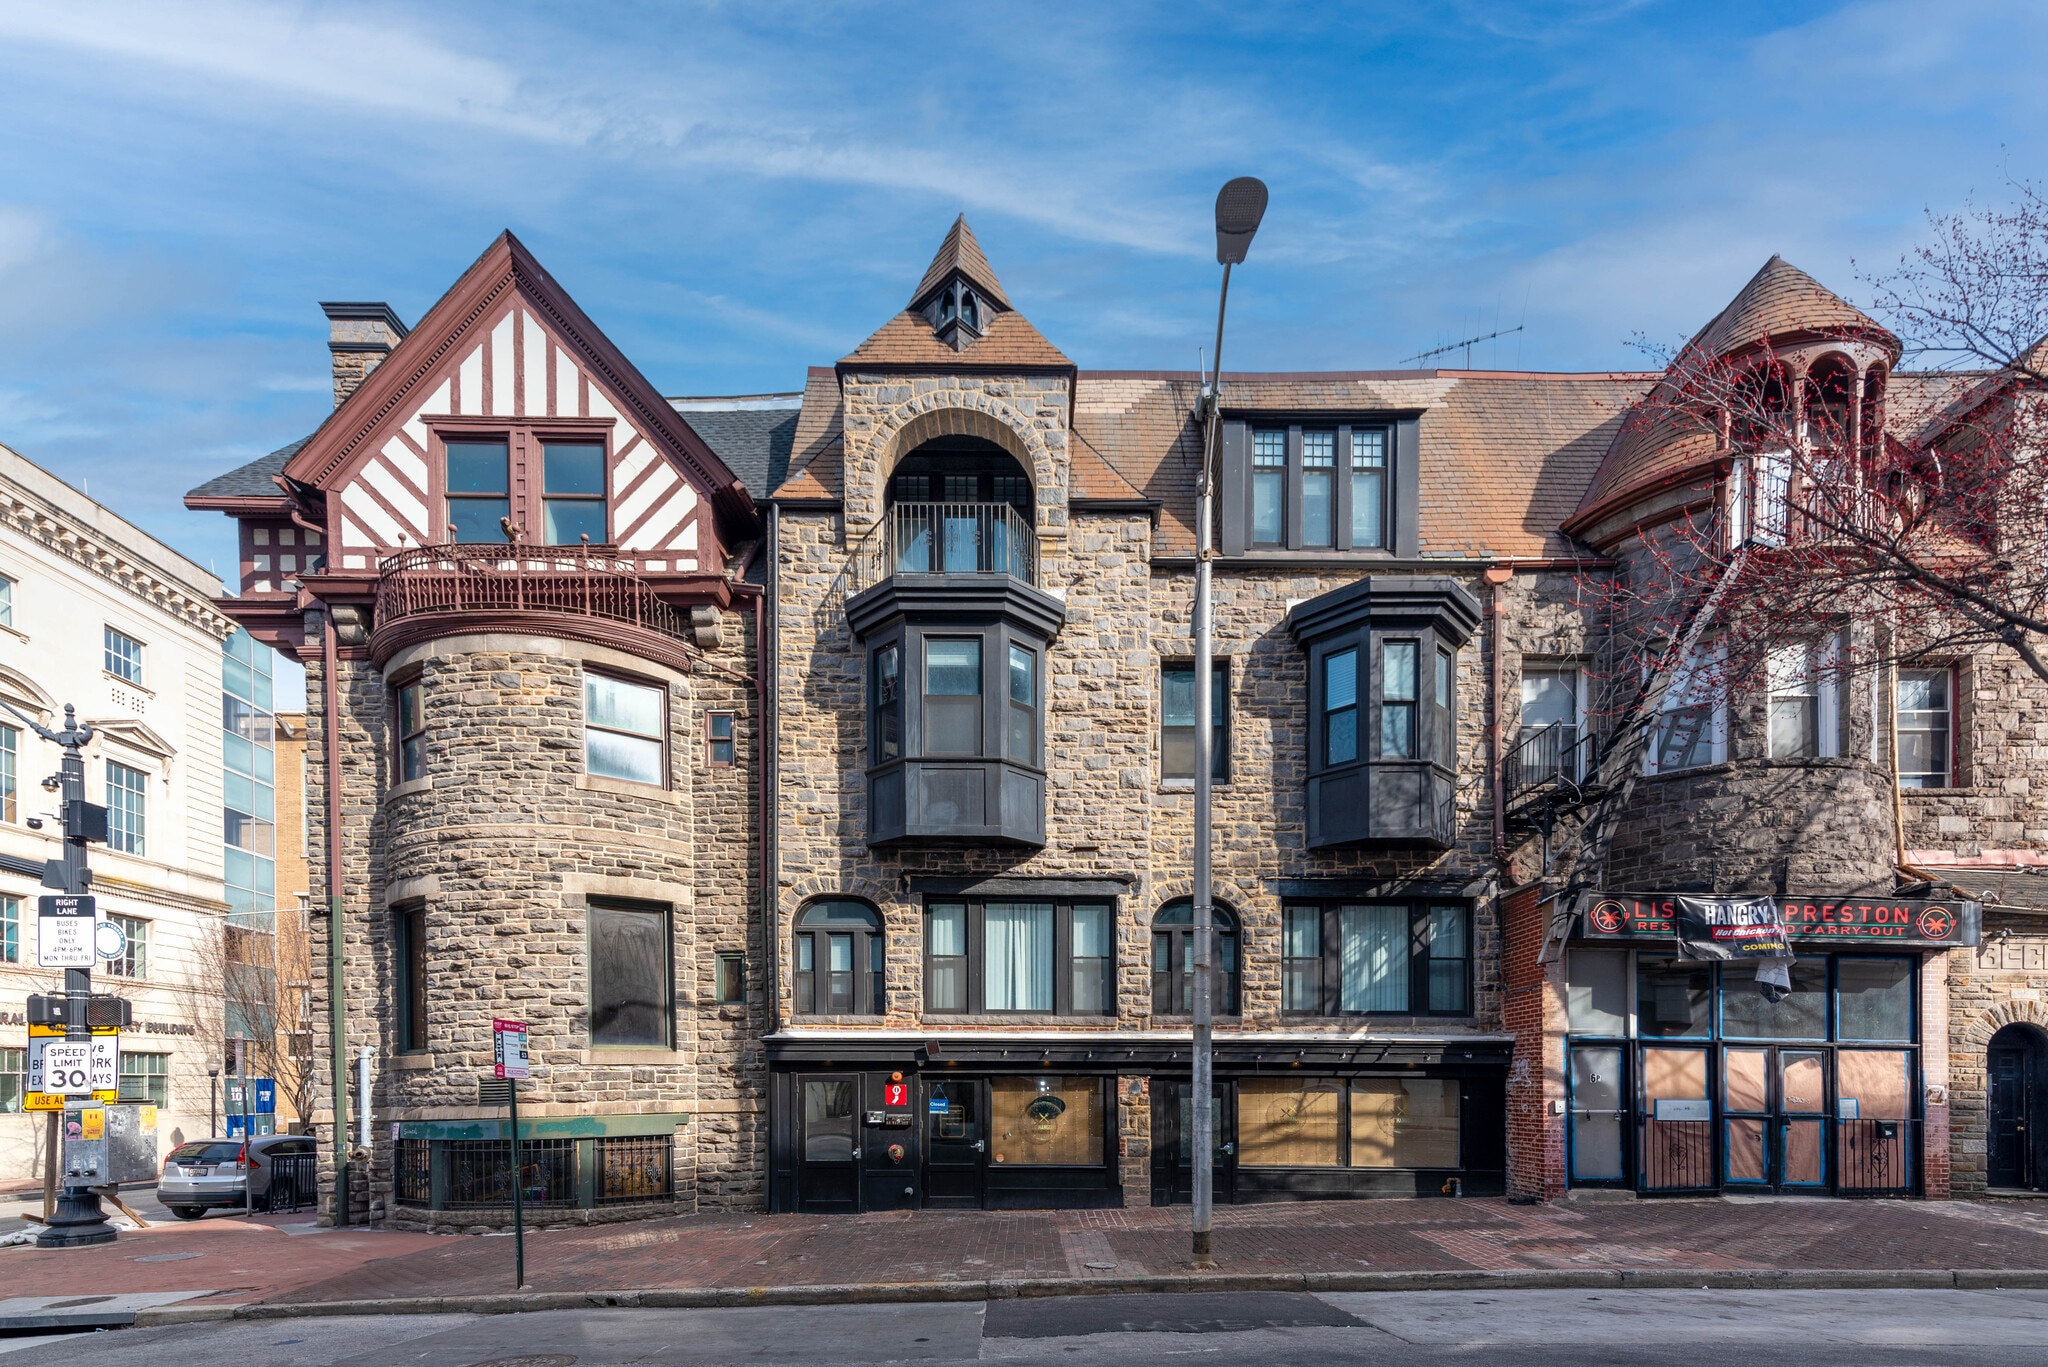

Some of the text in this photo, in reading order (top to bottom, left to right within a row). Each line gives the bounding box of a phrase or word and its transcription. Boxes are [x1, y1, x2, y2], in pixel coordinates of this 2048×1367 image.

[1634, 901, 1674, 918] LIS
[1785, 904, 1909, 924] PRESTON
[1704, 905, 1768, 926] HANGRY
[1803, 925, 1905, 936] CARRY-OUT
[1742, 943, 1785, 951] COMING
[145, 1022, 196, 1036] BUILDING
[50, 1049, 86, 1057] SPEED
[54, 1059, 82, 1067] LIMIT
[50, 1070, 86, 1088] 30
[34, 1096, 51, 1105] USE
